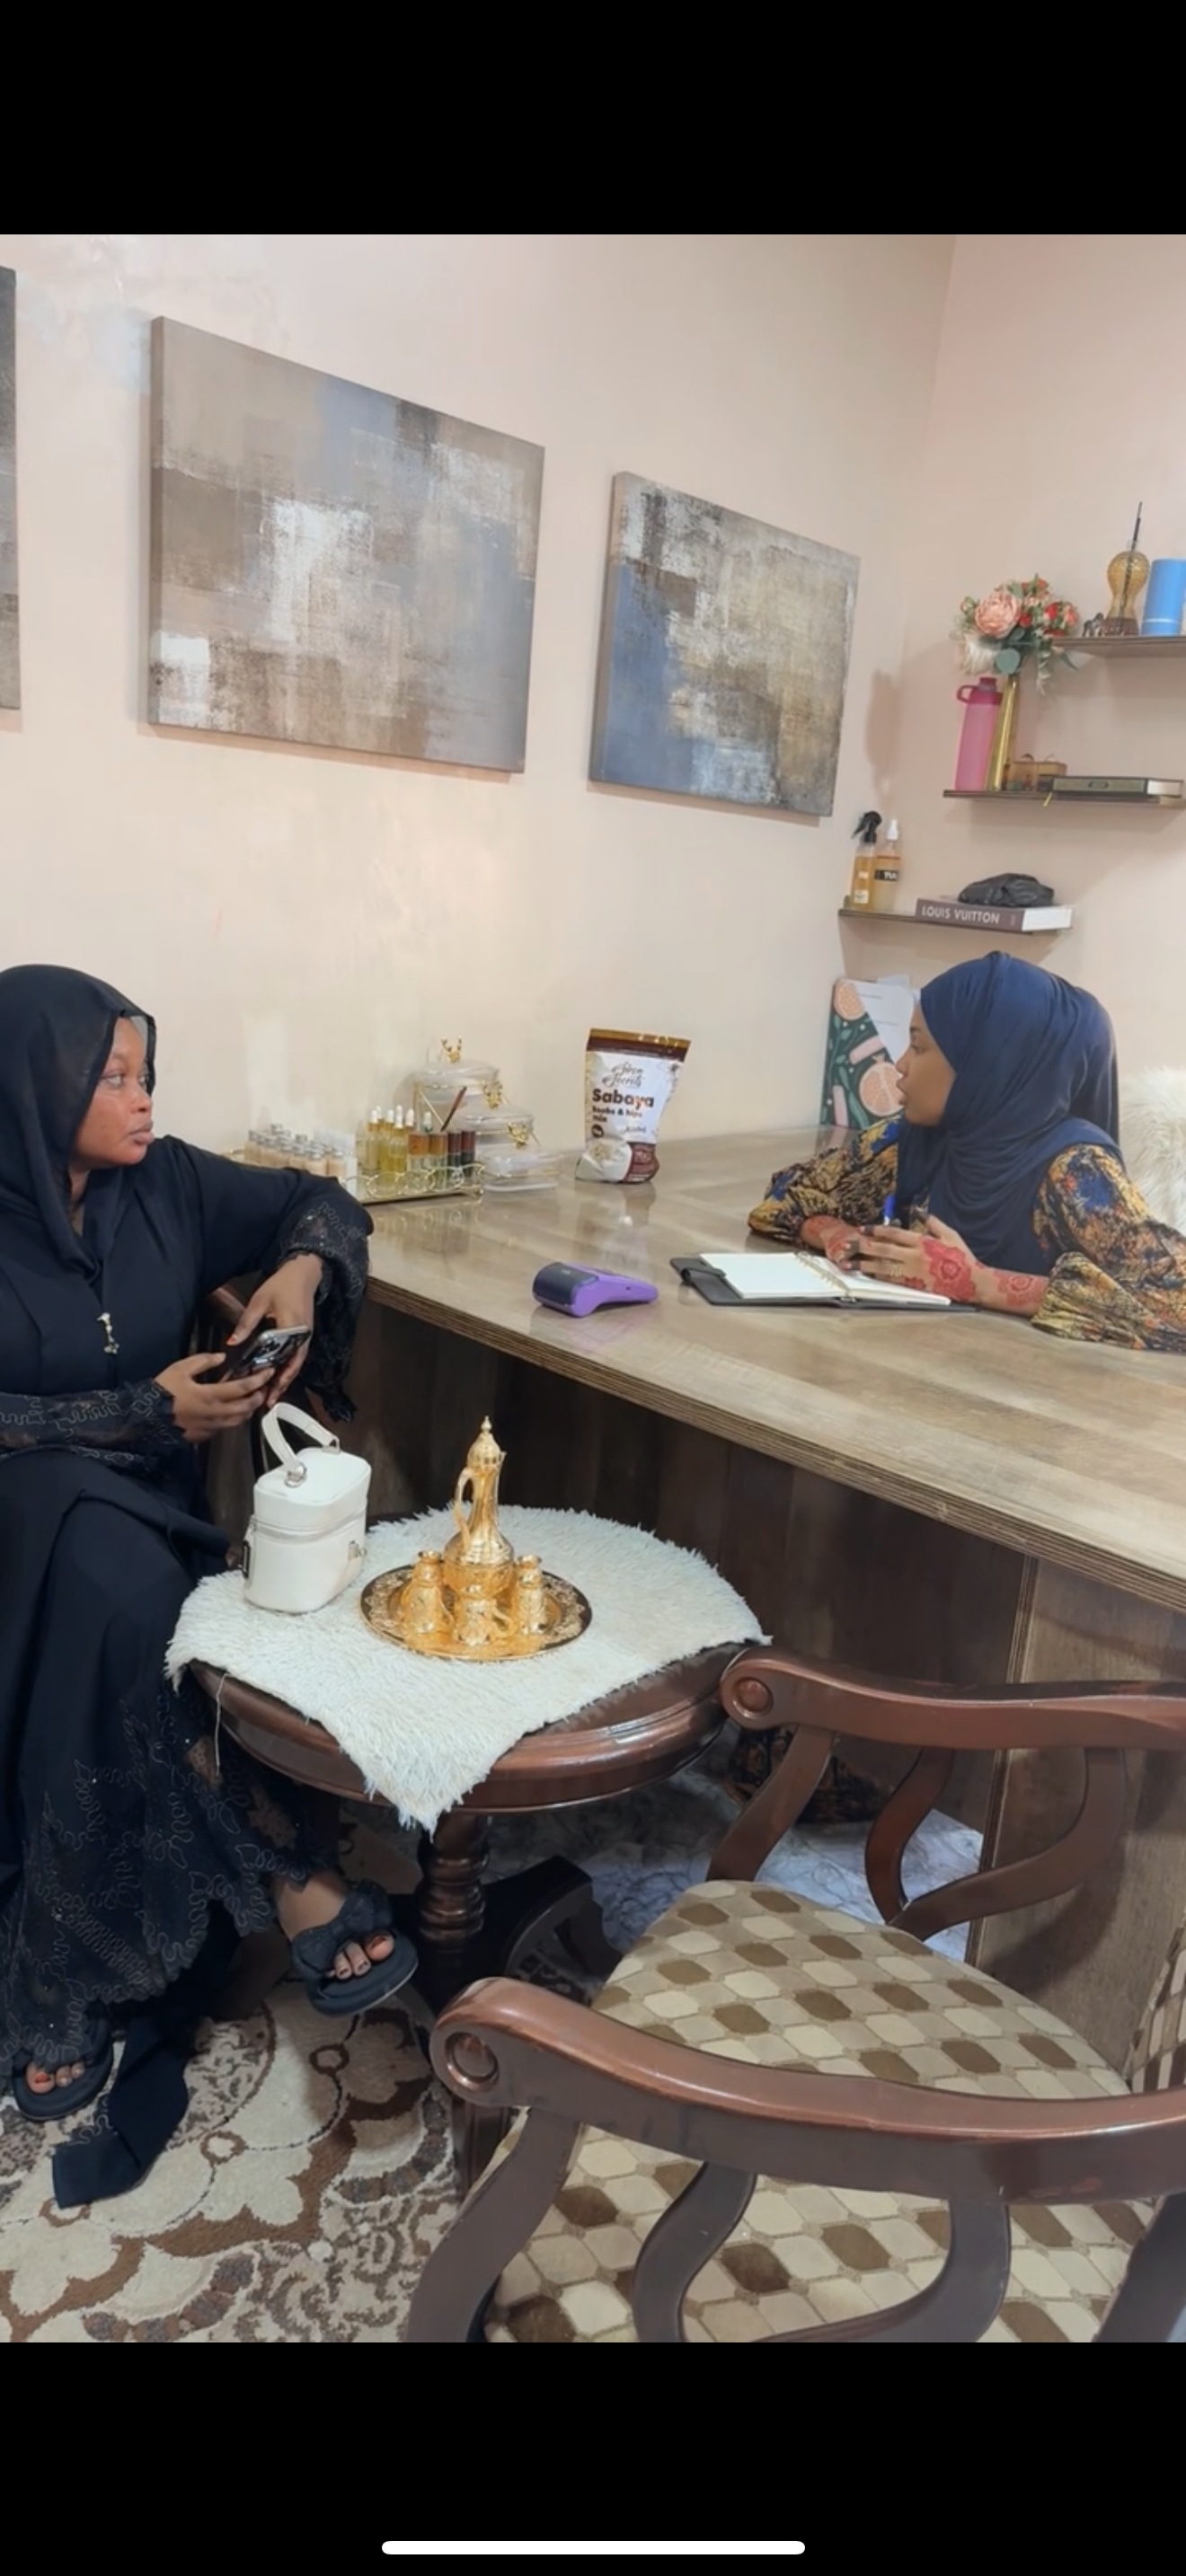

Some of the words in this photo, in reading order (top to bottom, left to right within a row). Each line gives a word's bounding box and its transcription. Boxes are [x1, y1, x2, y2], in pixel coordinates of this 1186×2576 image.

[922, 905, 951, 919] LOUIS
[953, 908, 1001, 924] VUITTON
[592, 1089, 654, 1110] Sabaya
